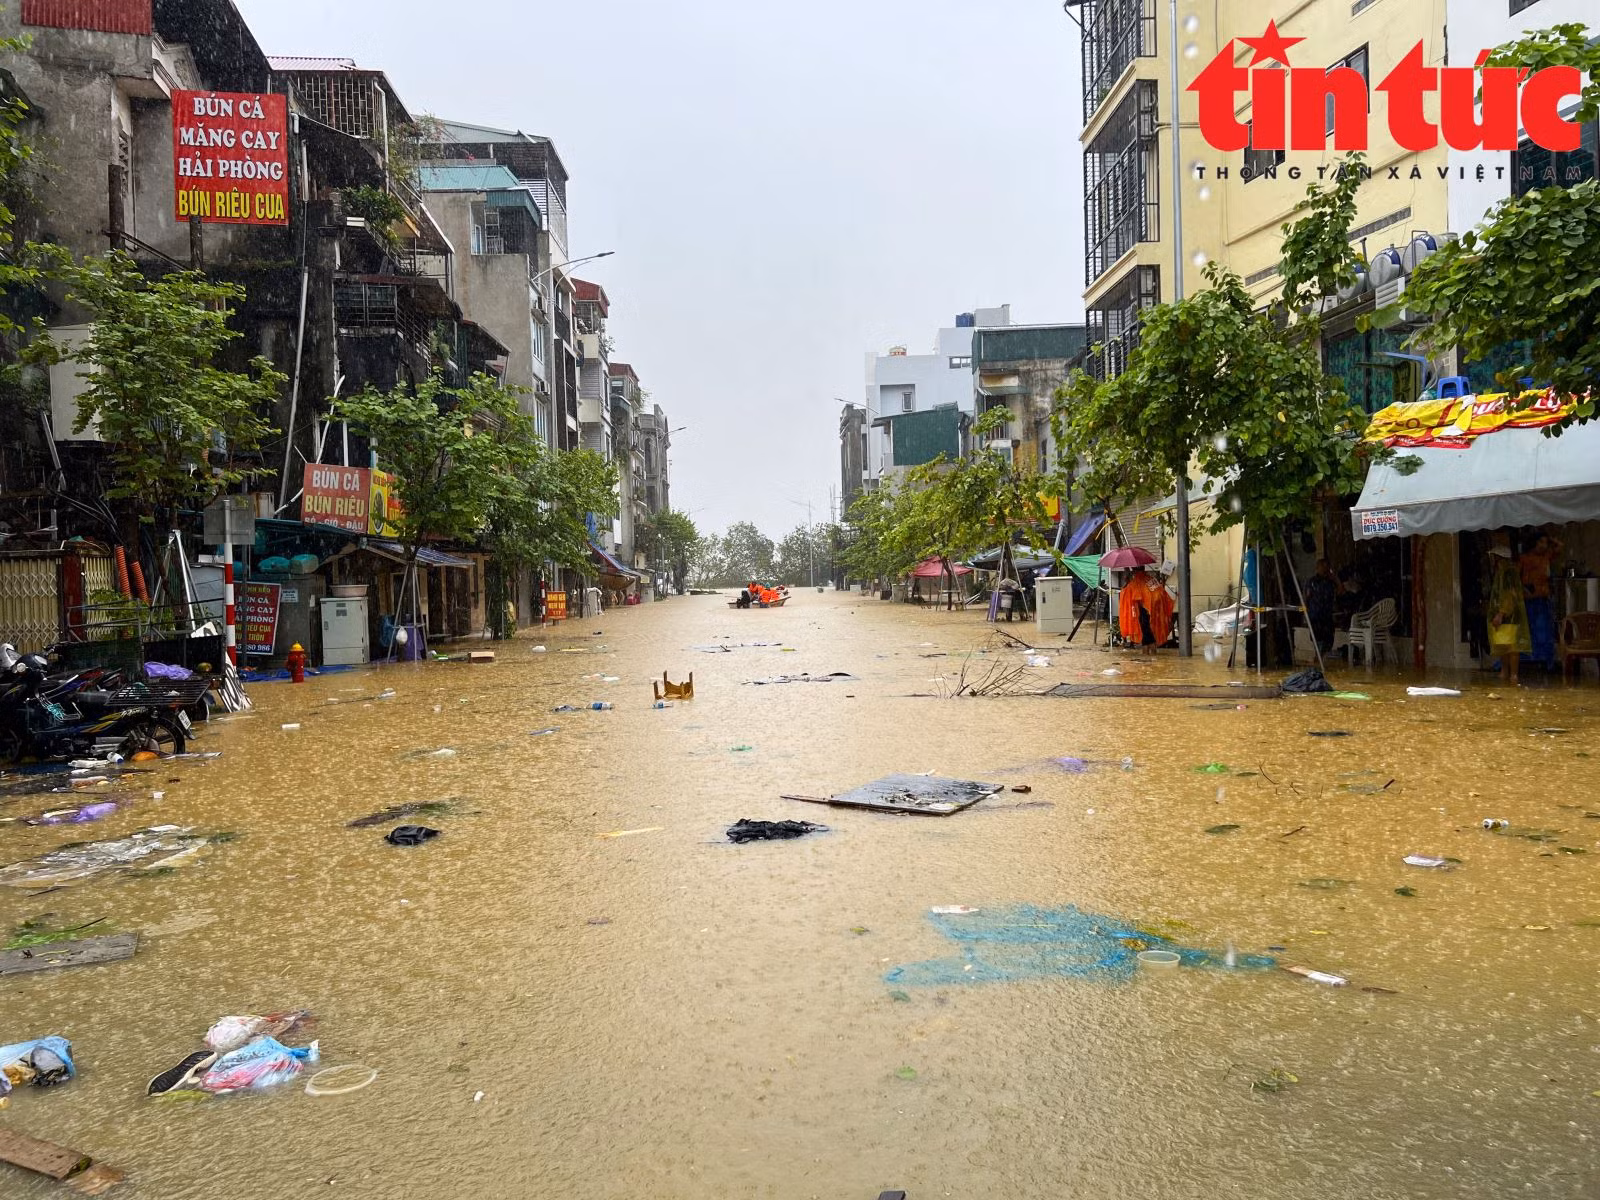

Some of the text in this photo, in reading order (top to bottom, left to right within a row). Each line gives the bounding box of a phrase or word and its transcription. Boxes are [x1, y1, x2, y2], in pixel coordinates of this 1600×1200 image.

[193, 93, 265, 119] BÚN CÁ
[180, 122, 280, 150] MĂNG CAY
[178, 151, 283, 180] HẢI PHÒNG
[178, 184, 285, 219] BÚN RIÊU CUA
[312, 467, 339, 489] BÚN
[343, 470, 360, 491] CÁ
[304, 492, 332, 514] BÚN
[335, 495, 365, 518] RIÊU
